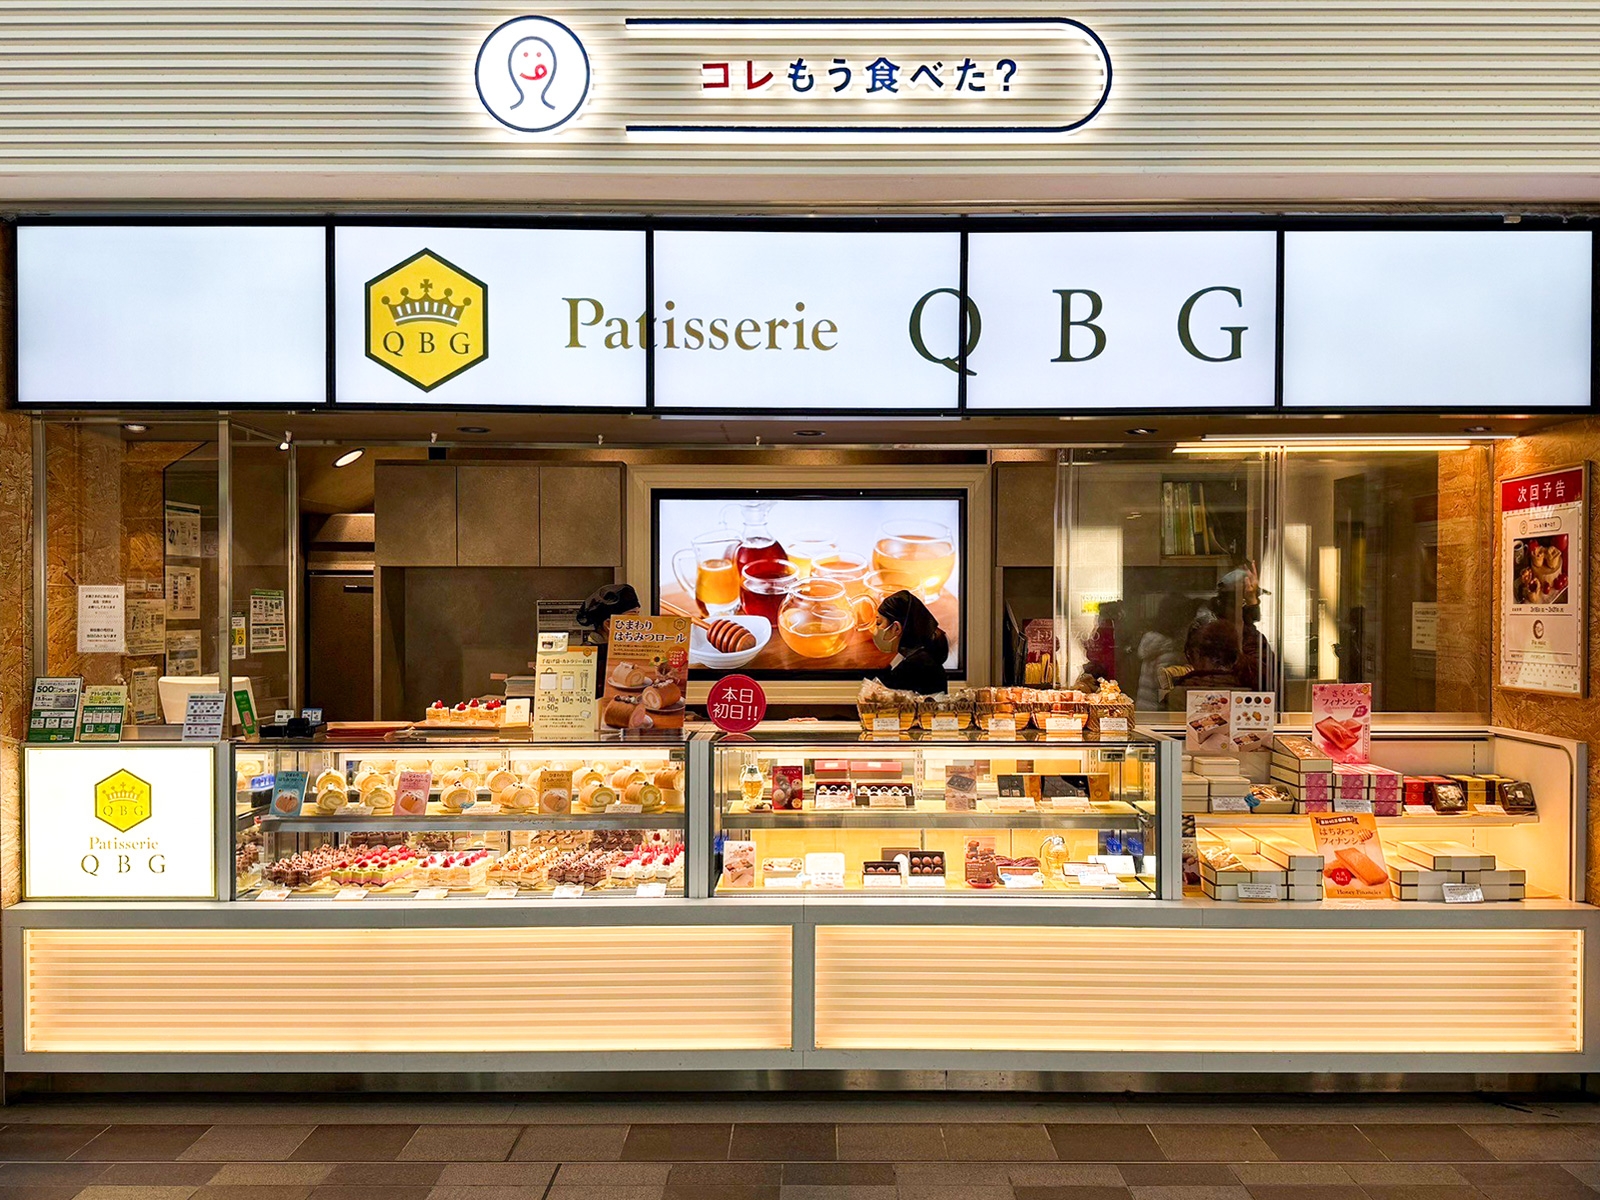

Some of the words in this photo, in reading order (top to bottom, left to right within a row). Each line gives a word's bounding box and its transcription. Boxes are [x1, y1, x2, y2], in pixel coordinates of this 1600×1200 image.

[701, 56, 1018, 94] コレもう食べた？
[562, 297, 839, 351] Patisserie
[1517, 480, 1566, 503] 次回予告
[615, 620, 652, 630] ひまわり
[614, 632, 686, 643] はちみつロール
[721, 686, 754, 704] 本日
[1332, 689, 1354, 698] さくら
[1322, 698, 1362, 706] フィナンシェ
[712, 702, 758, 721] 初日!!
[1319, 827, 1355, 836] はちみつ
[89, 836, 159, 850] Patisserie
